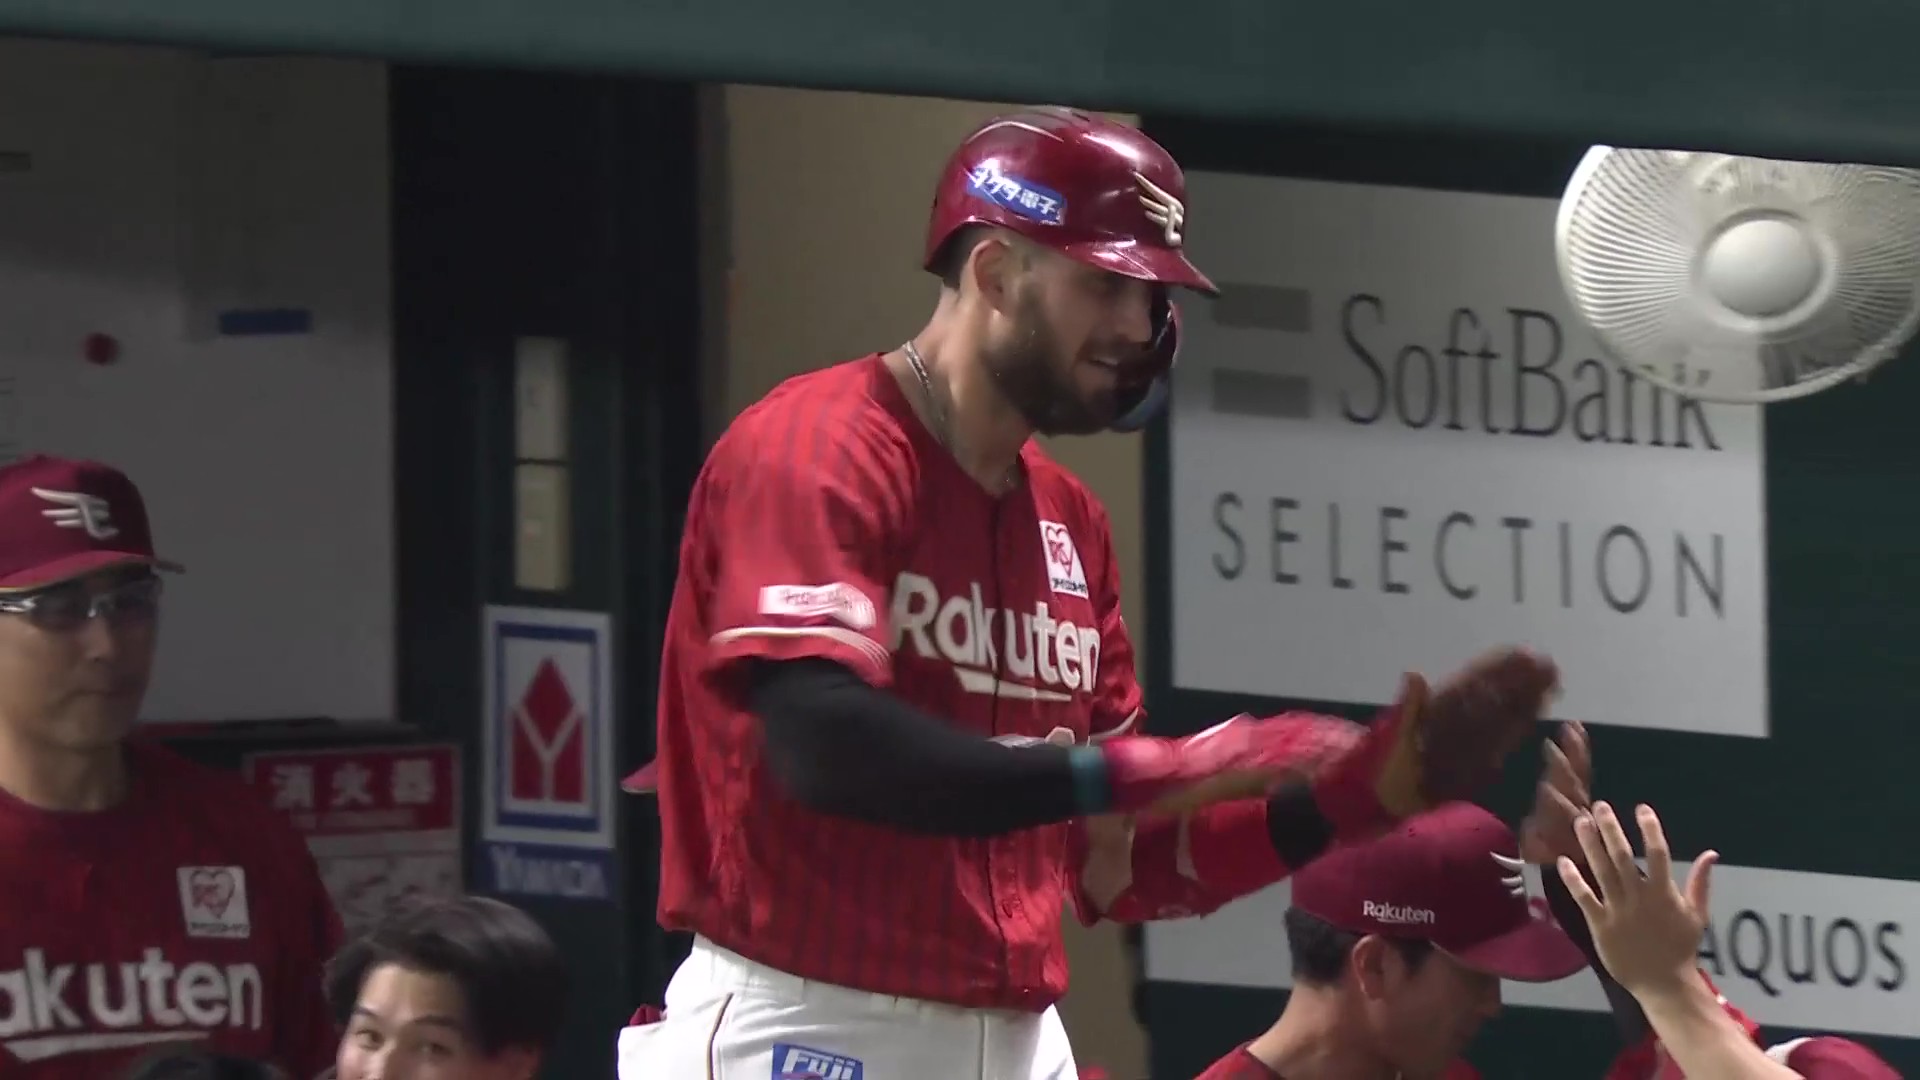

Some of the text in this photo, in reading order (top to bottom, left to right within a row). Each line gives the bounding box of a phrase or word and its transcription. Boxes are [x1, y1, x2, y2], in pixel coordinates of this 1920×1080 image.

[1338, 293, 1723, 451] SoftBank
[1211, 492, 1725, 620] SELECTION
[891, 571, 1100, 693] Rakuten
[1363, 900, 1436, 925] Rakuten
[1696, 909, 1906, 998] AQUOS
[0, 947, 263, 1038] akuten
